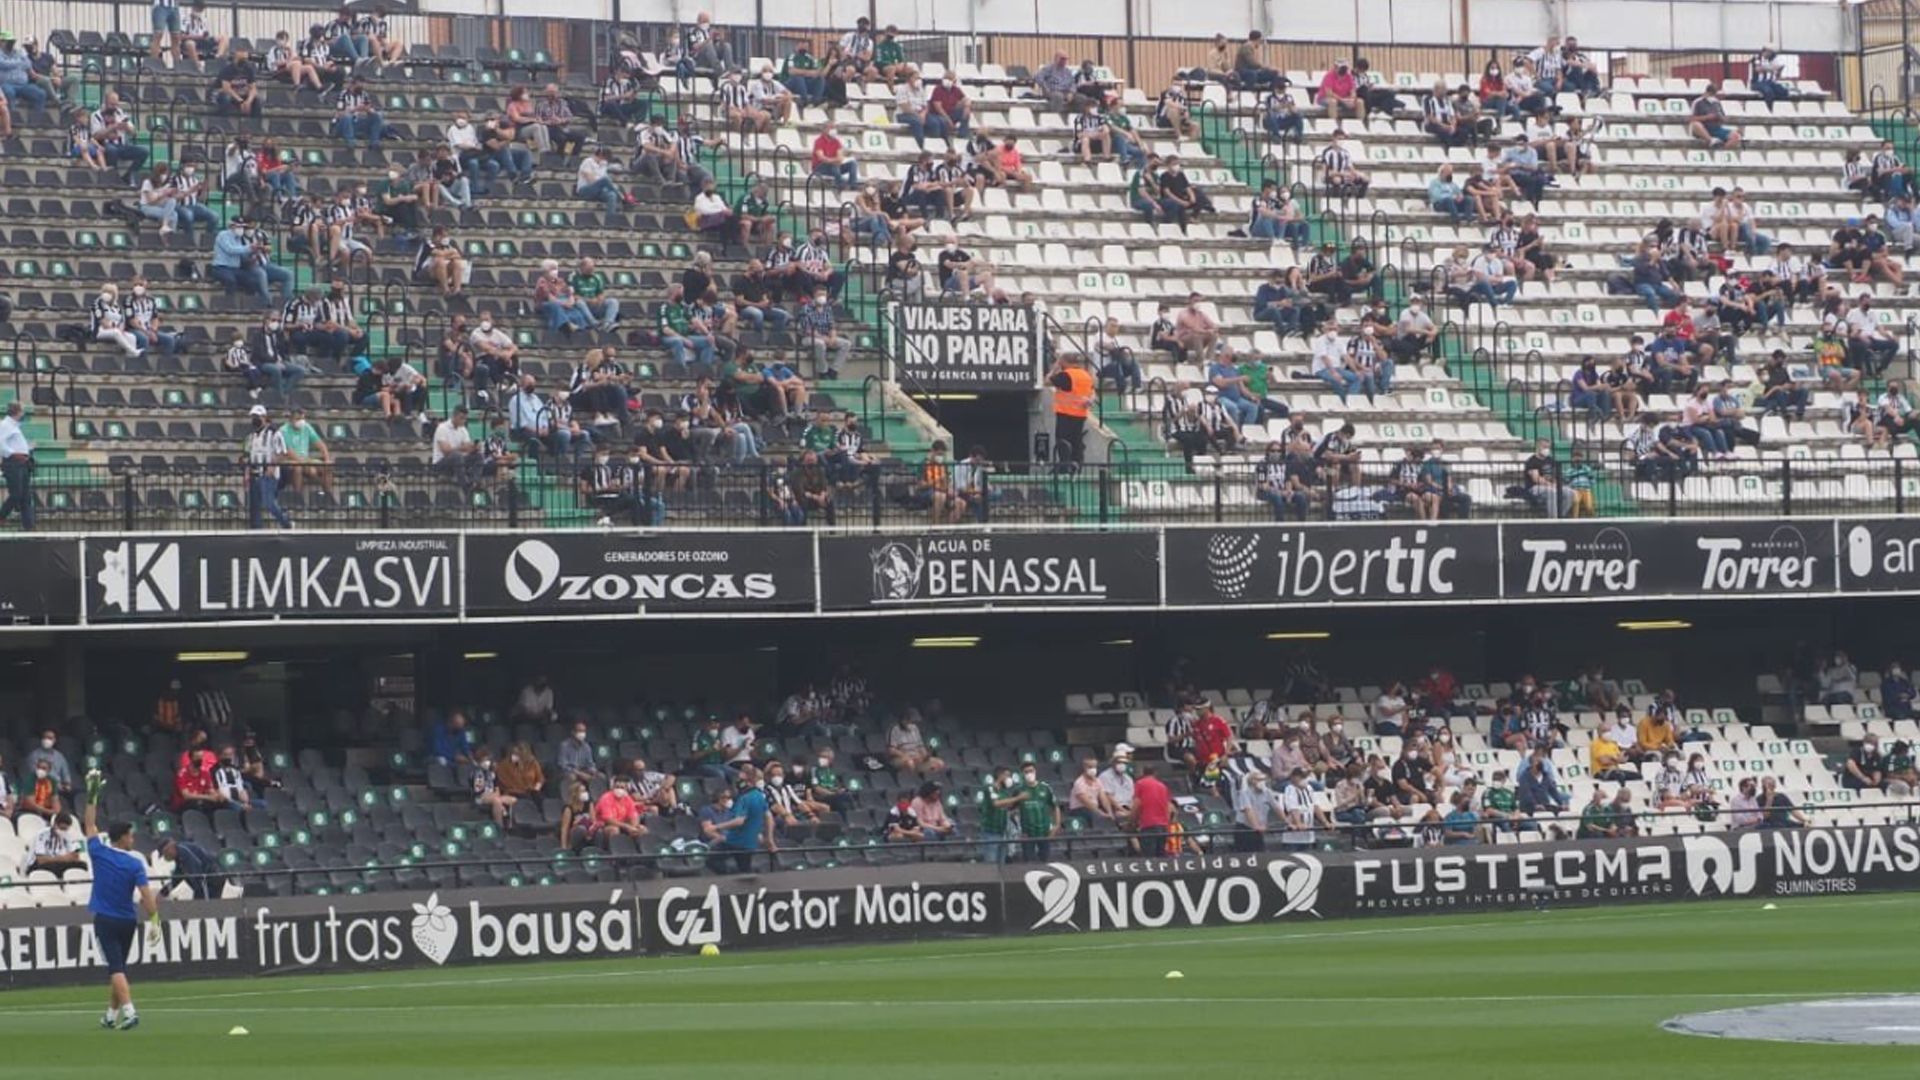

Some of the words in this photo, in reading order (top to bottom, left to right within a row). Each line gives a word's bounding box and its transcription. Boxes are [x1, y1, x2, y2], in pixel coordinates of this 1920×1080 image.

[903, 306, 972, 331] VIAJES
[977, 308, 1029, 332] PARA
[904, 333, 940, 365] NO
[946, 335, 1029, 365] PARAR
[980, 371, 993, 381] DE
[996, 371, 1030, 383] VIAJES
[604, 551, 676, 562] GENERADORES
[677, 551, 690, 562] DE
[692, 551, 729, 562] OZONO
[928, 539, 968, 554] AGUA
[972, 538, 992, 552] DE
[1277, 530, 1457, 597] ibertic
[1521, 539, 1642, 593] Torres
[1696, 537, 1818, 591] Torres
[199, 556, 451, 609] LIMKASVI
[929, 557, 1107, 595] BENASSAL
[1086, 853, 1258, 876] electricidad
[1353, 845, 1672, 896] FUSTECMA
[1775, 877, 1857, 894] SUMINISTRES
[729, 886, 840, 934] Víctor
[854, 881, 987, 925] Maicas
[1088, 875, 1261, 931] NOVO
[254, 906, 403, 967] frutas
[469, 889, 633, 958] bausá
